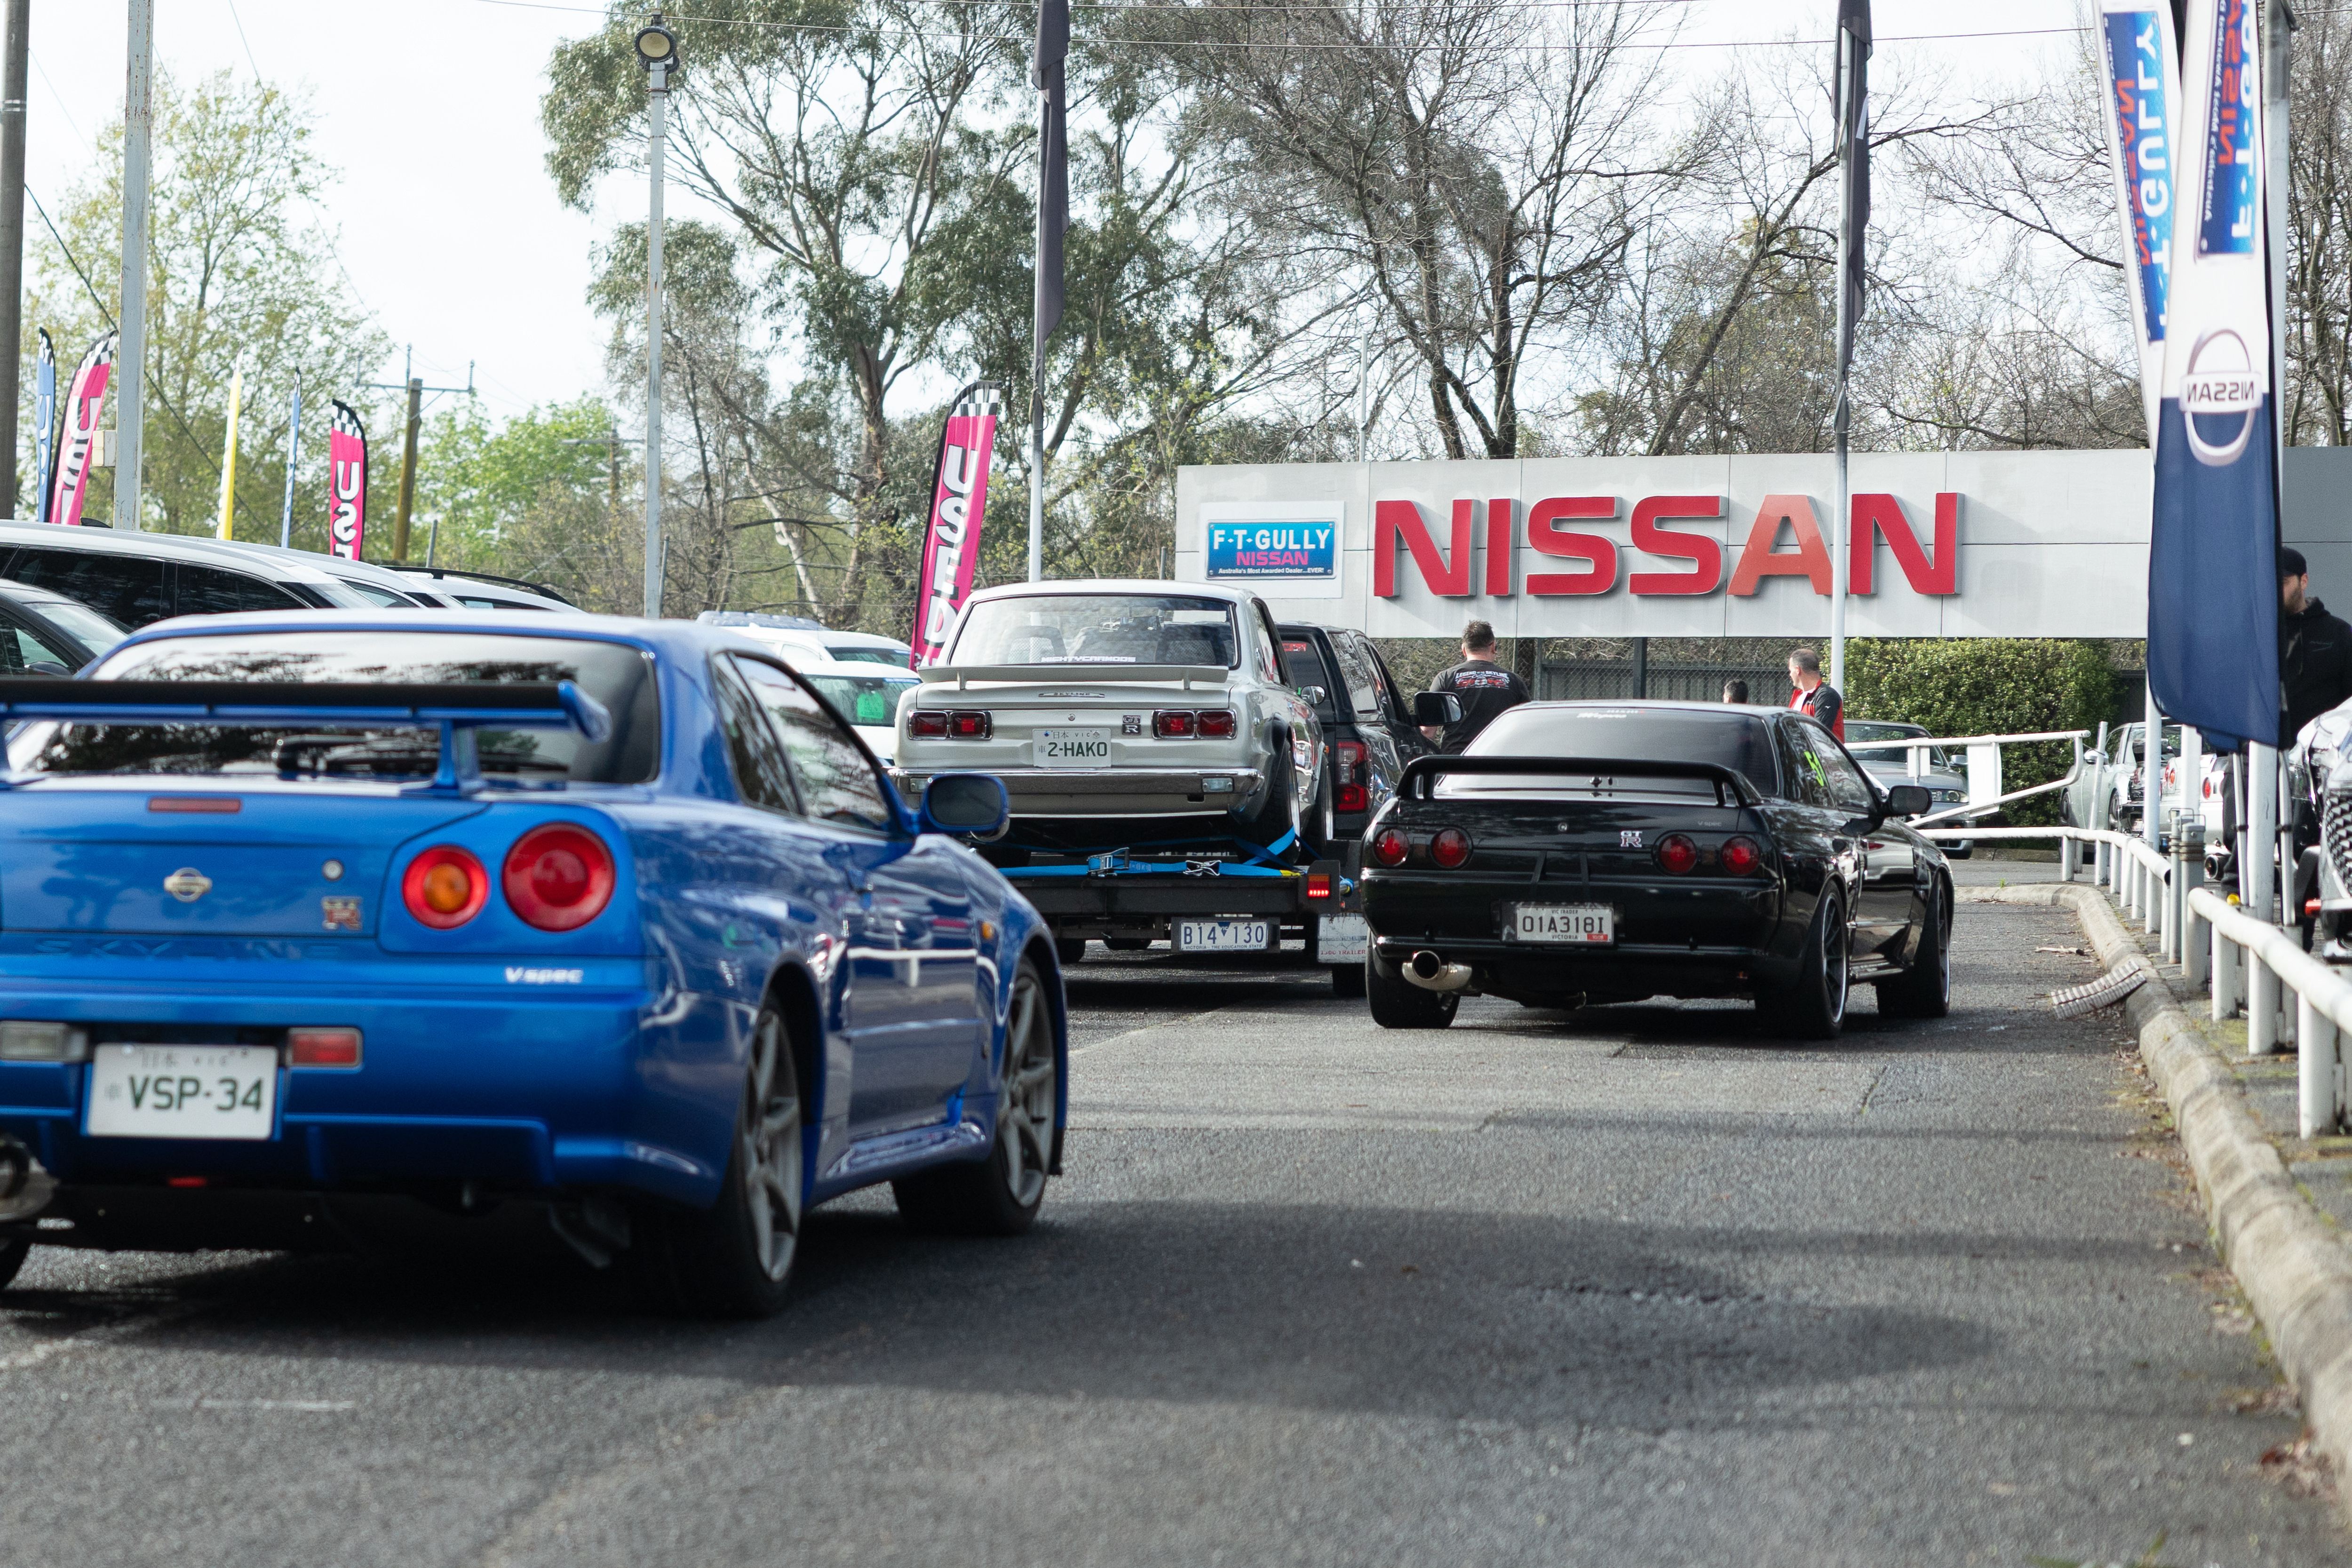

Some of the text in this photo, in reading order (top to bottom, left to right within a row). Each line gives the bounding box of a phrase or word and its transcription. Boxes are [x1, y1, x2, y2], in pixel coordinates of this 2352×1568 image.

[923, 444, 979, 646] USED
[1374, 492, 1961, 597] NISSAN
[1236, 551, 1309, 565] NISSAN
[1048, 741, 1107, 757] 2-HAKO
[1621, 836, 1642, 847] R
[1184, 925, 1264, 945] B14 130
[128, 1075, 263, 1111] VSP-34
